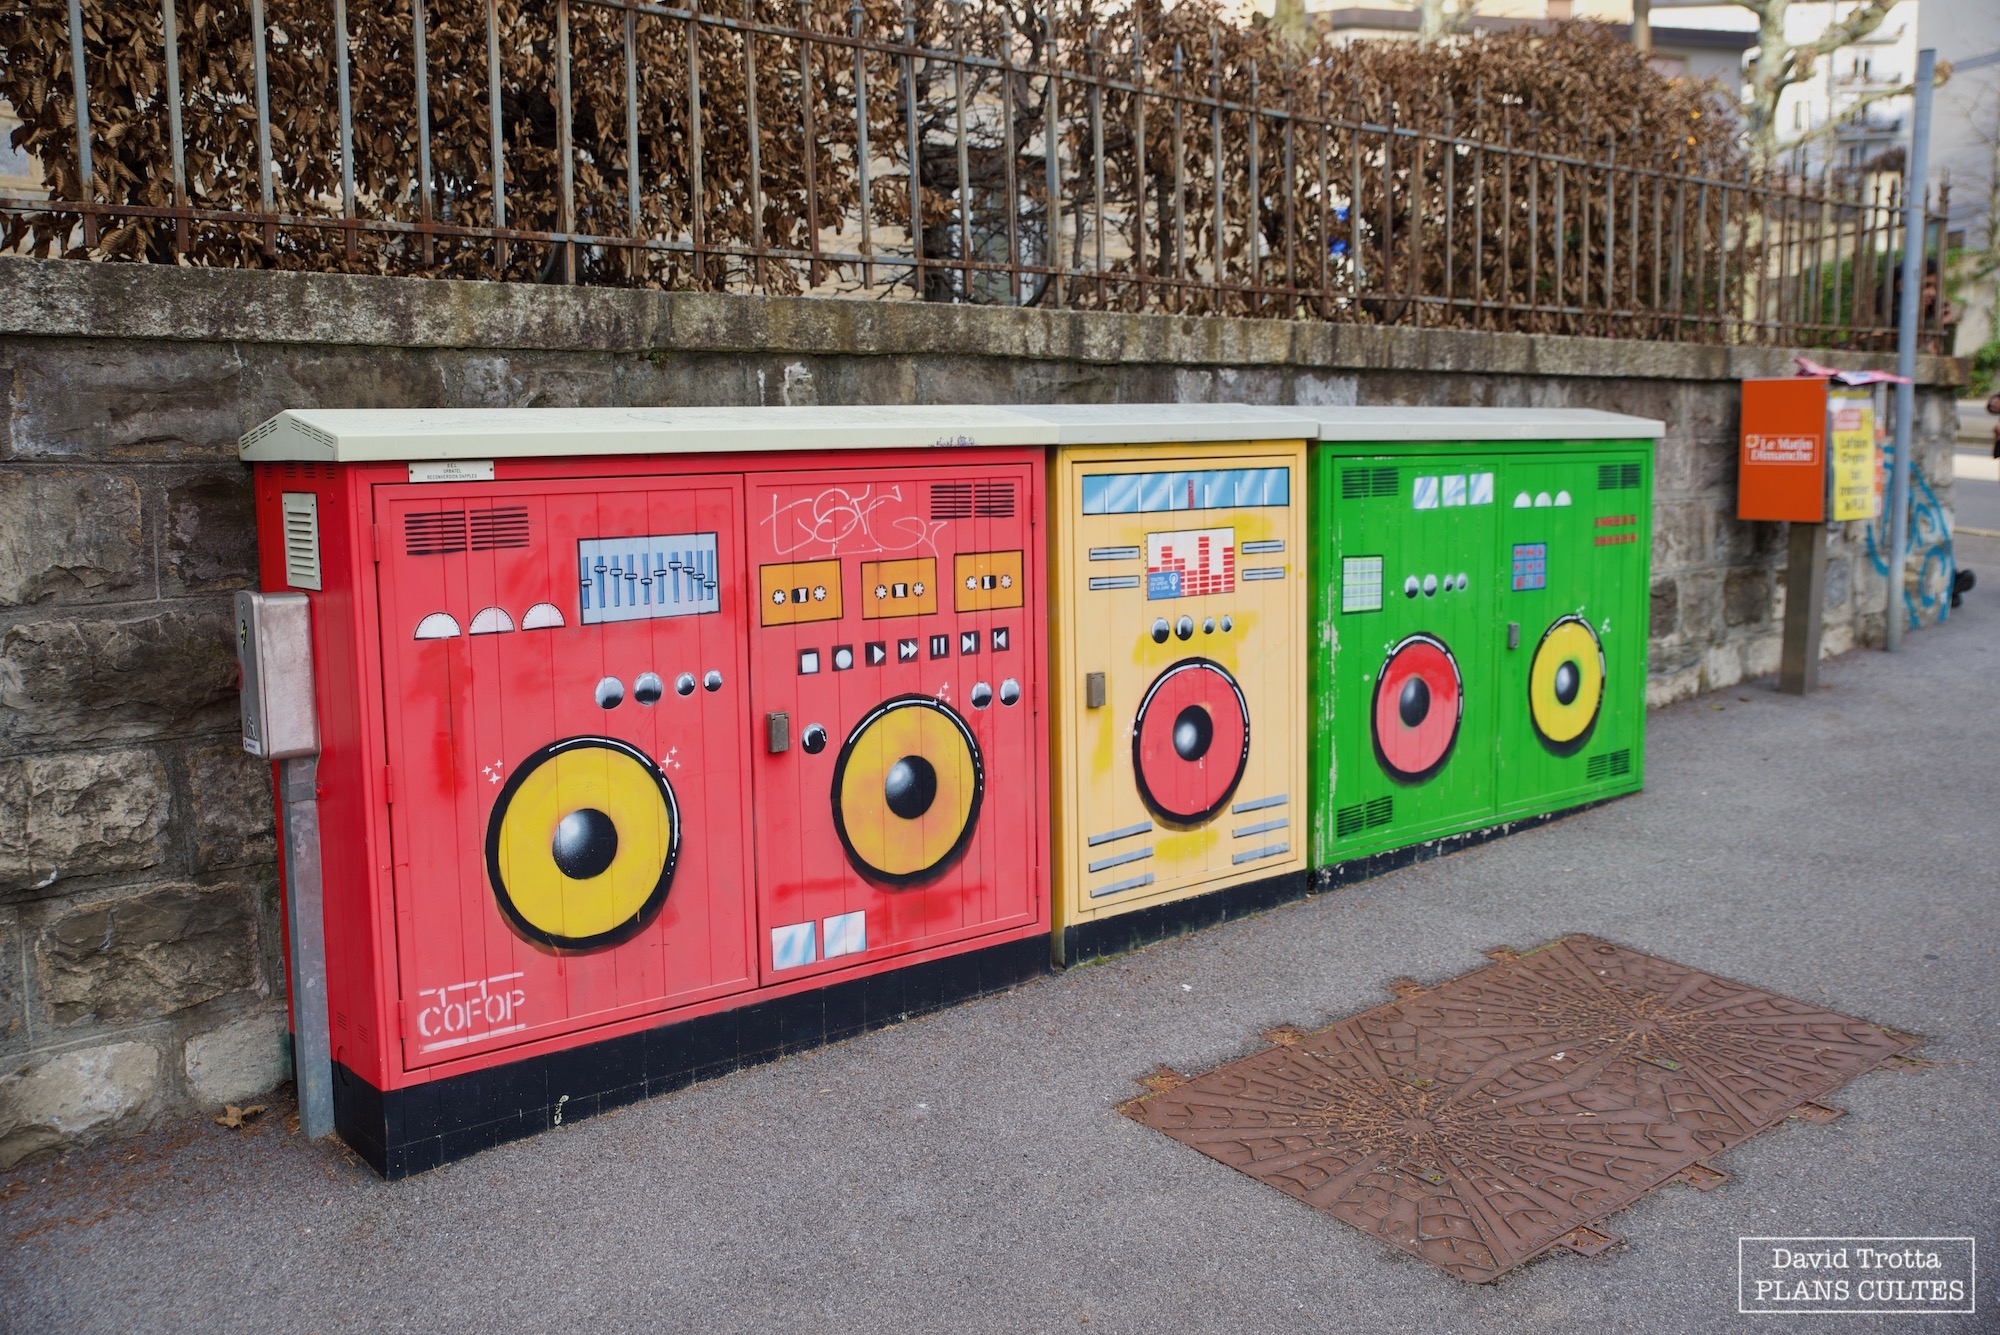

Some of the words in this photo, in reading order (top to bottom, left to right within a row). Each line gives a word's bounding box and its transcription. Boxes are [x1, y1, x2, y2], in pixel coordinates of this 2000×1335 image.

[1760, 438, 1776, 450] Le
[1777, 438, 1813, 450] Matin
[1751, 449, 1813, 461] Dimanche
[418, 989, 525, 1037] COFOP
